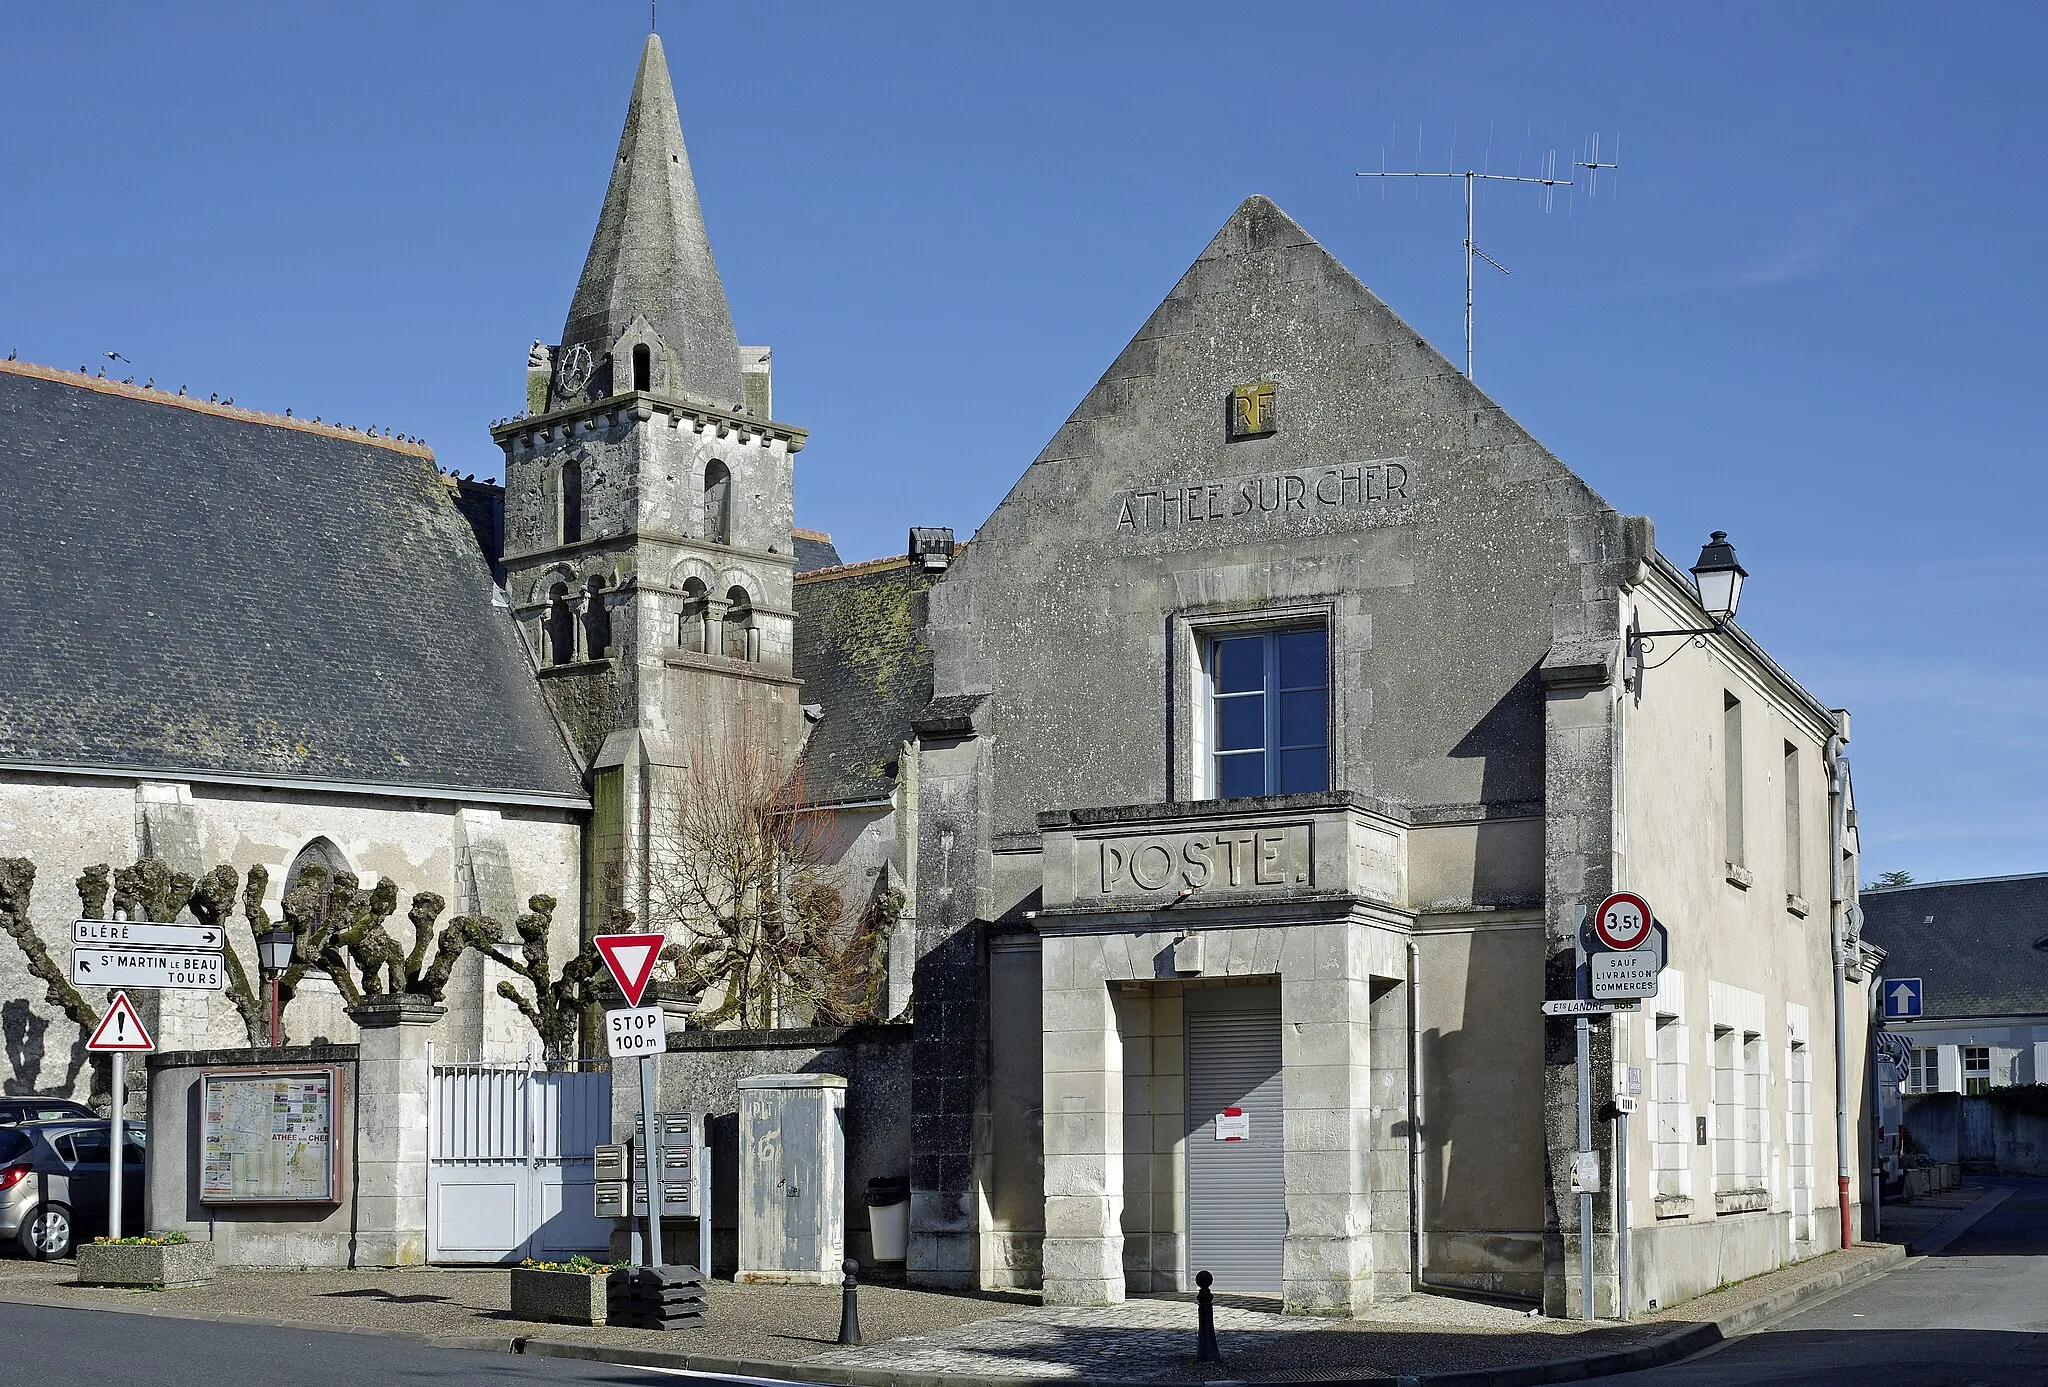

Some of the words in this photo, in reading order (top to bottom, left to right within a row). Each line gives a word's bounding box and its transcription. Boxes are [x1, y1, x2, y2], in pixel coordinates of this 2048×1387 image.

[1235, 392, 1276, 427] RF
[1116, 483, 1224, 531] ATHEE
[1231, 475, 1307, 518] SUR
[1316, 463, 1409, 506] CHER
[1606, 912, 1640, 932] 3,5t
[80, 925, 129, 939] BLÉRÉ
[117, 956, 167, 969] MARTIN
[170, 961, 180, 969] LE
[184, 959, 217, 970] BEAU
[1610, 958, 1637, 968] SAUF
[168, 972, 217, 985] TOURS
[1596, 970, 1652, 980] LIVRAISON
[1595, 981, 1653, 992] COMMERCES
[1567, 1001, 1604, 1012] LANDRE
[612, 1014, 657, 1032] STOP
[308, 1134, 330, 1142] CHER
